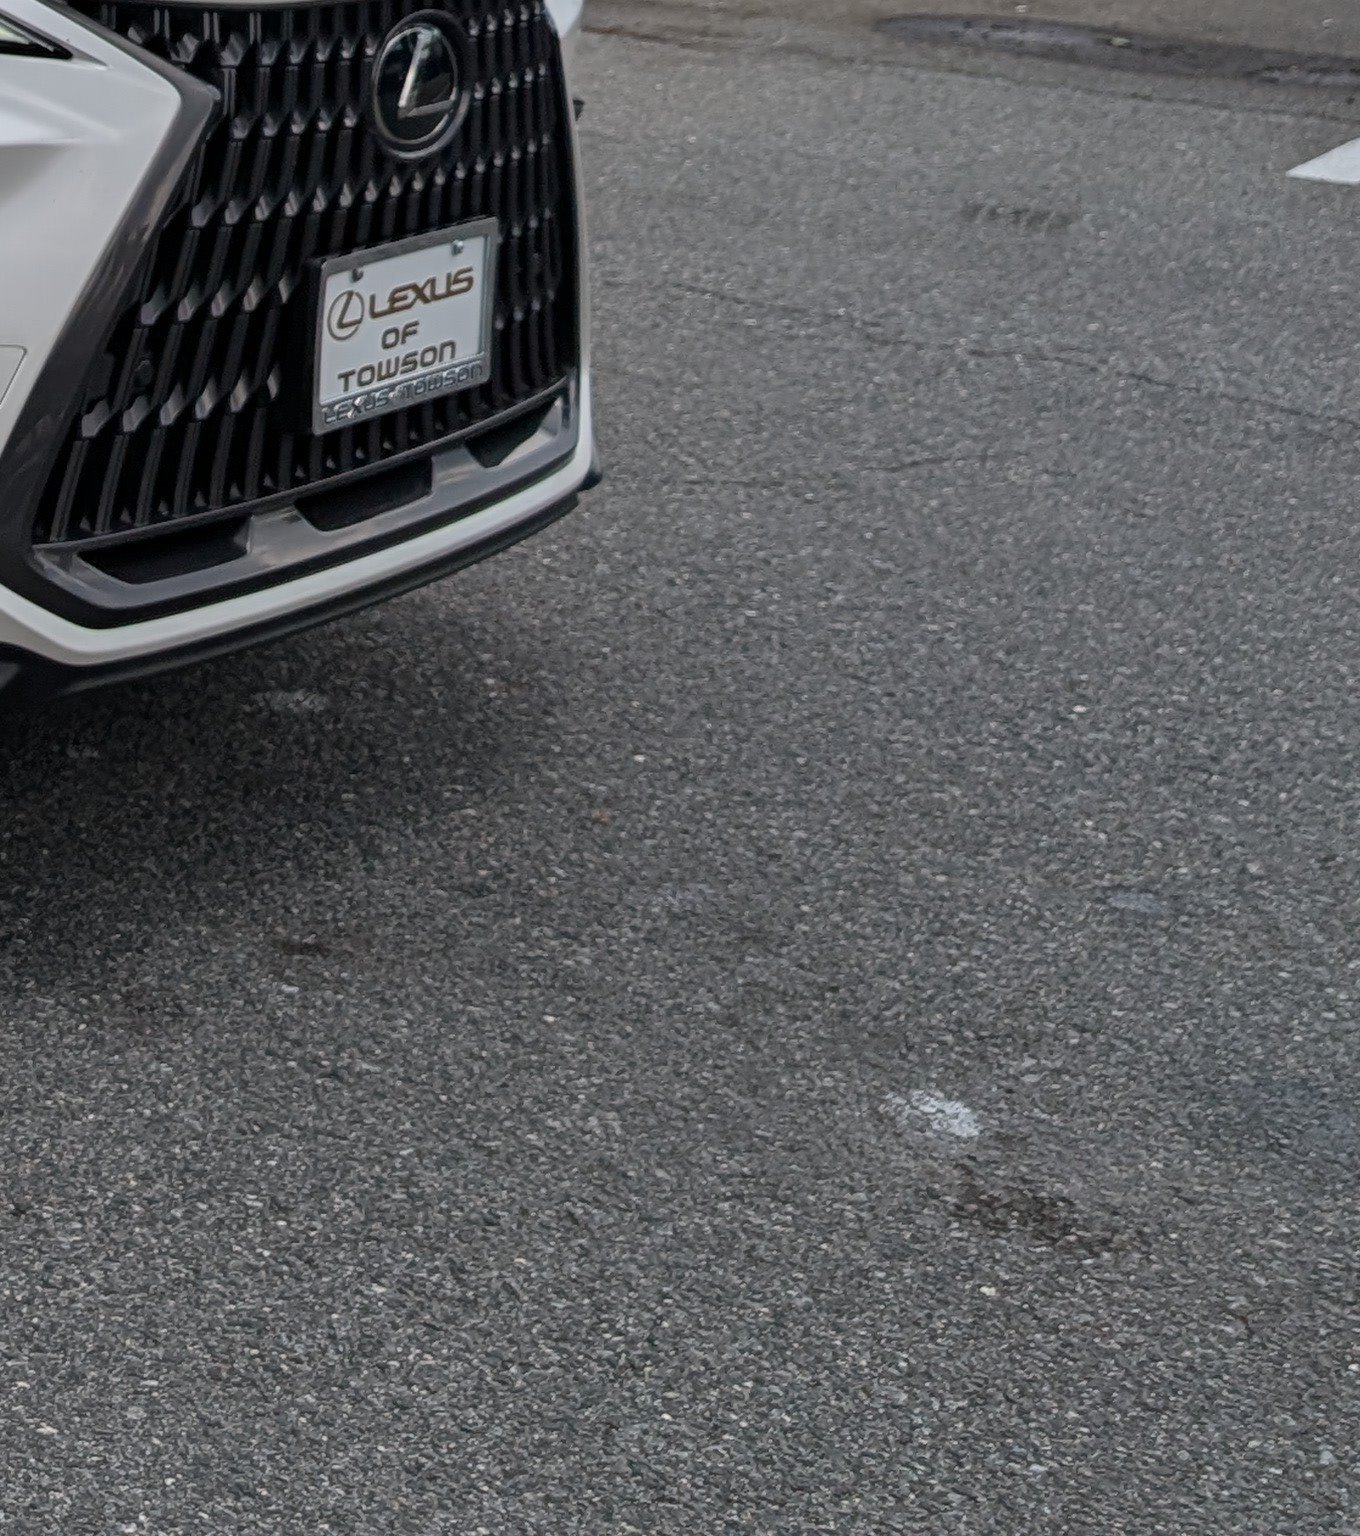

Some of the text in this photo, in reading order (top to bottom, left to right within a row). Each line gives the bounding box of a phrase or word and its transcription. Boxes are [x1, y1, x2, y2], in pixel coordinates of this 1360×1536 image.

[368, 266, 474, 319] LEXUS
[381, 320, 420, 350] OF
[337, 340, 457, 392] TOWSON
